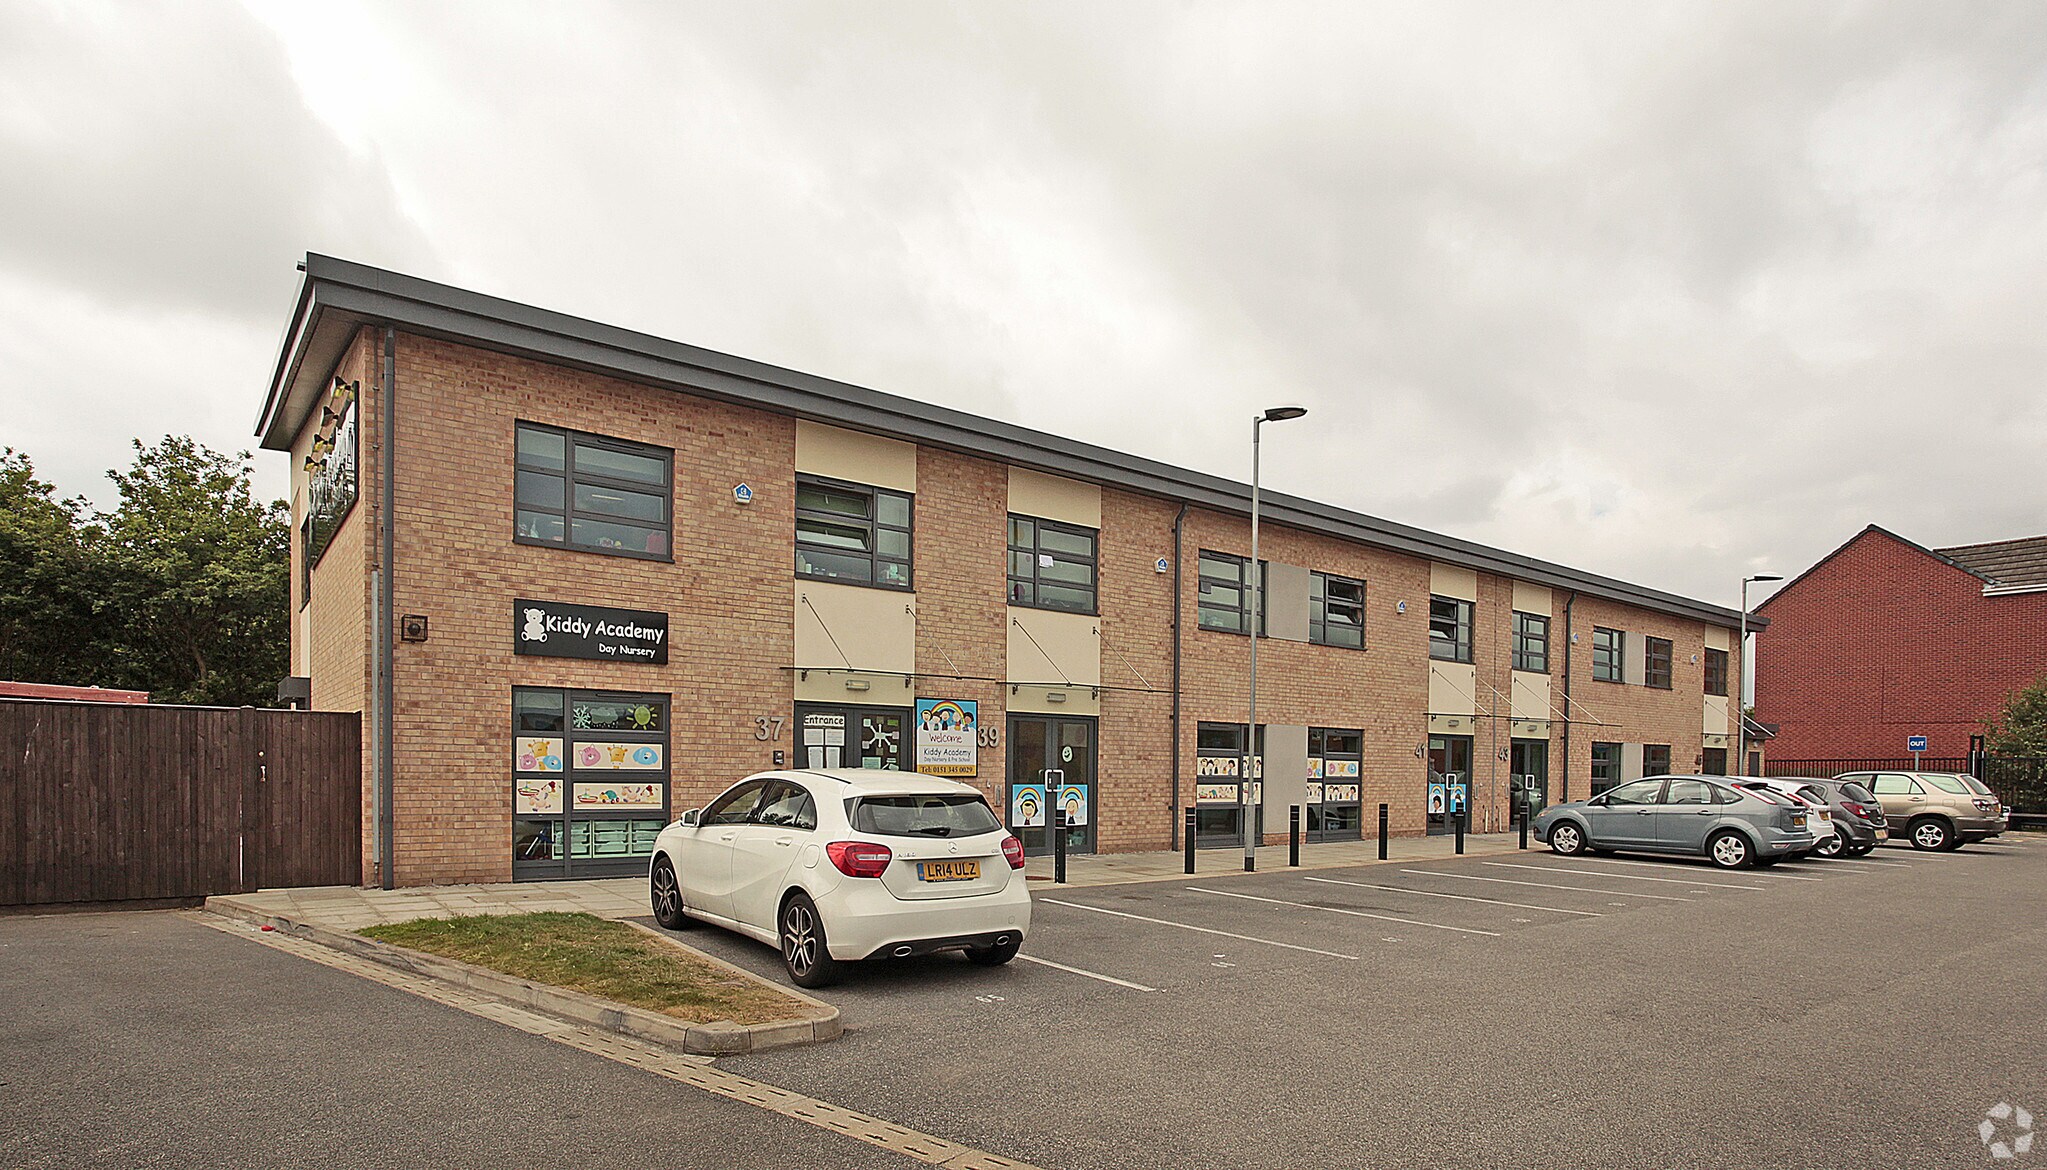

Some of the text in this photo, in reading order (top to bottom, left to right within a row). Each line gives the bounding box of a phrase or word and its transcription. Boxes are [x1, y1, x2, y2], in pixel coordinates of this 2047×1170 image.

[546, 614, 664, 645] Kiddy Academy
[598, 642, 656, 659] Day Nursery
[804, 714, 844, 725] Entrance
[755, 715, 785, 741] 37
[929, 733, 963, 743] Welcome
[978, 725, 1000, 748] 39
[924, 748, 971, 758] Kiddy Academy
[1414, 743, 1426, 759] 41
[927, 862, 977, 877] LR14 ULZ
